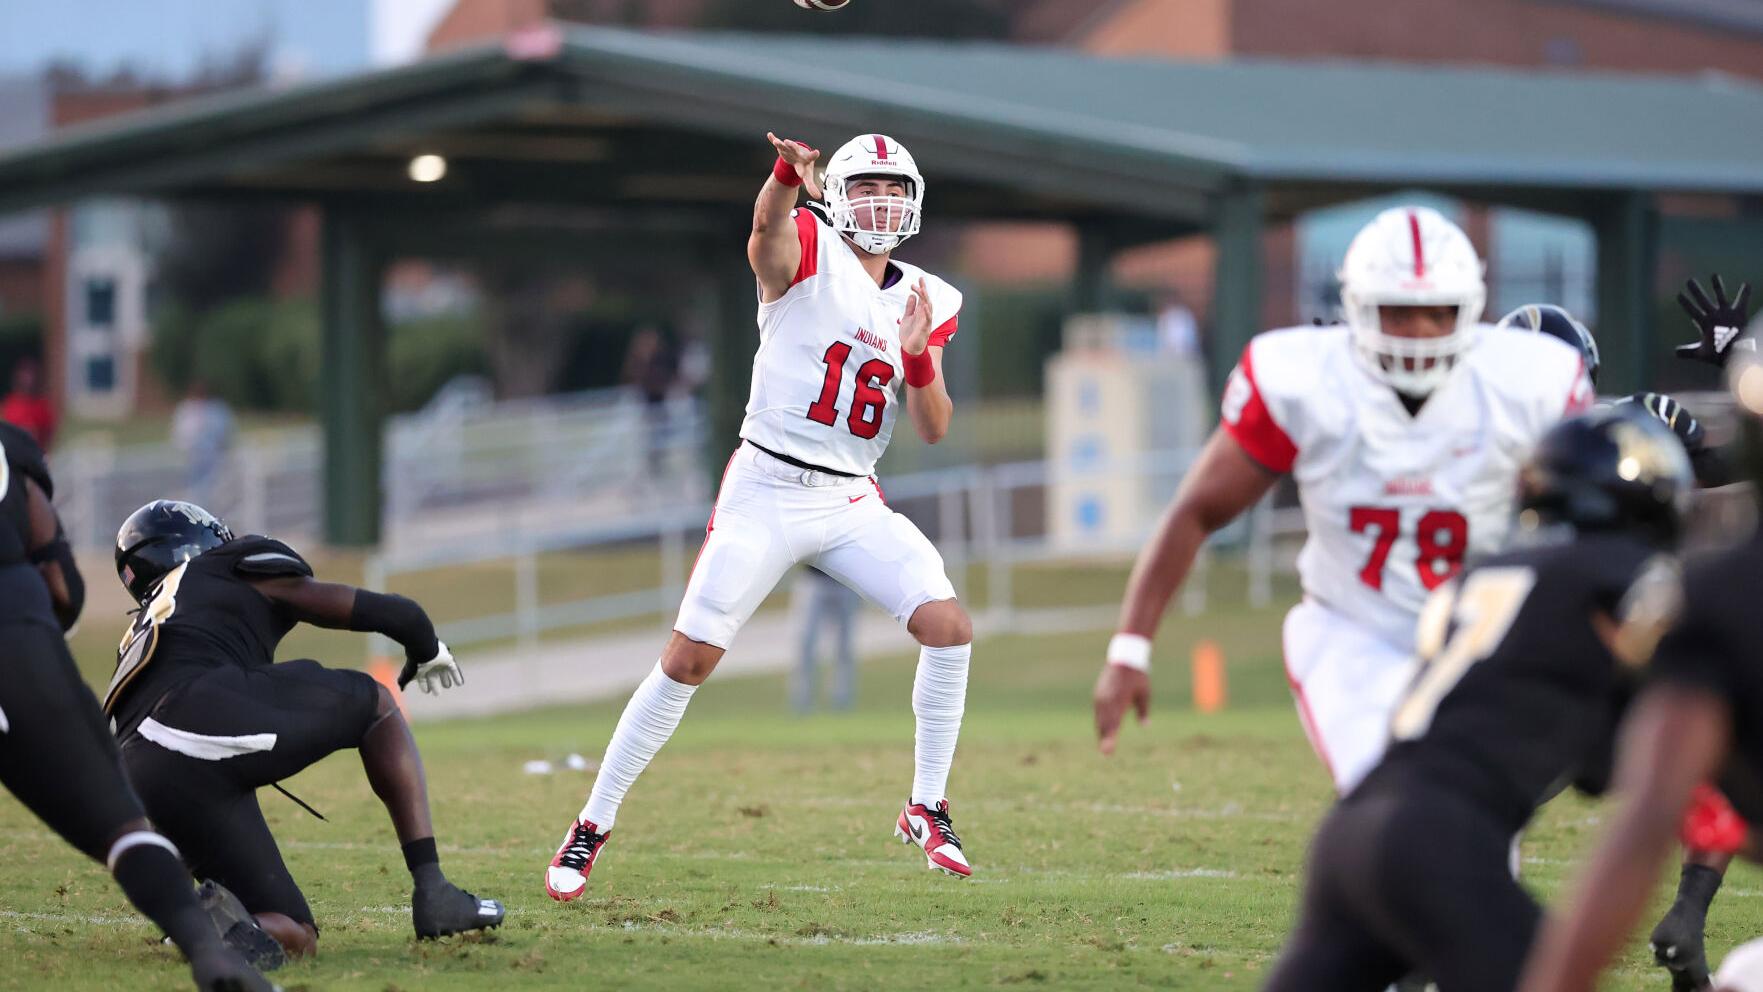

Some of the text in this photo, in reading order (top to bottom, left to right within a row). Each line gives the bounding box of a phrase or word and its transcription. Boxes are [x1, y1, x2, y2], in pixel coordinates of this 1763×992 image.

[854, 327, 888, 352] INDIANS
[806, 340, 895, 440] 16
[1348, 506, 1469, 592] 78
